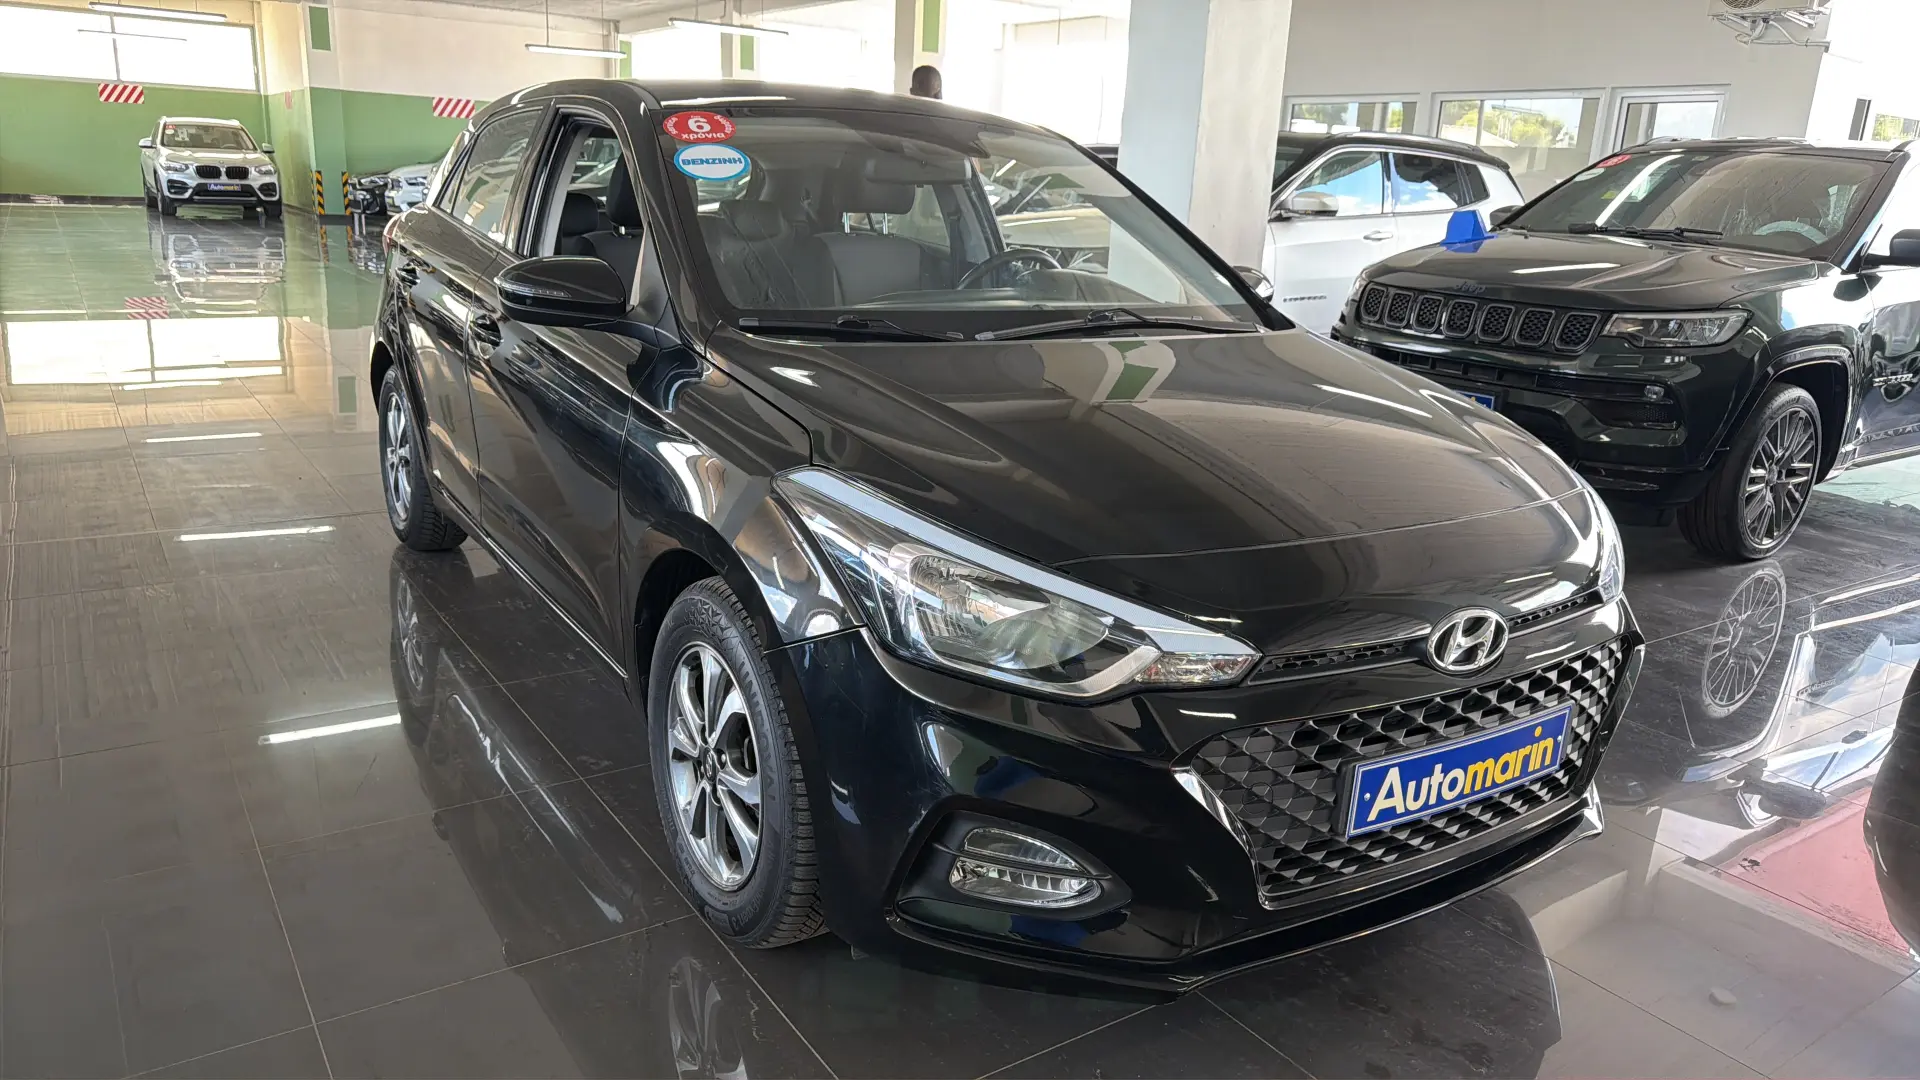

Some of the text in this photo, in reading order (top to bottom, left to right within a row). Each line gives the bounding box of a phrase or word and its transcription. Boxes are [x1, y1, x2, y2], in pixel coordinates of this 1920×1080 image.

[687, 117, 711, 133] 6
[681, 131, 726, 140] χρόνια
[681, 157, 743, 166] ΒΕΝΖΙΝΗ
[1366, 726, 1554, 821] Automarin
